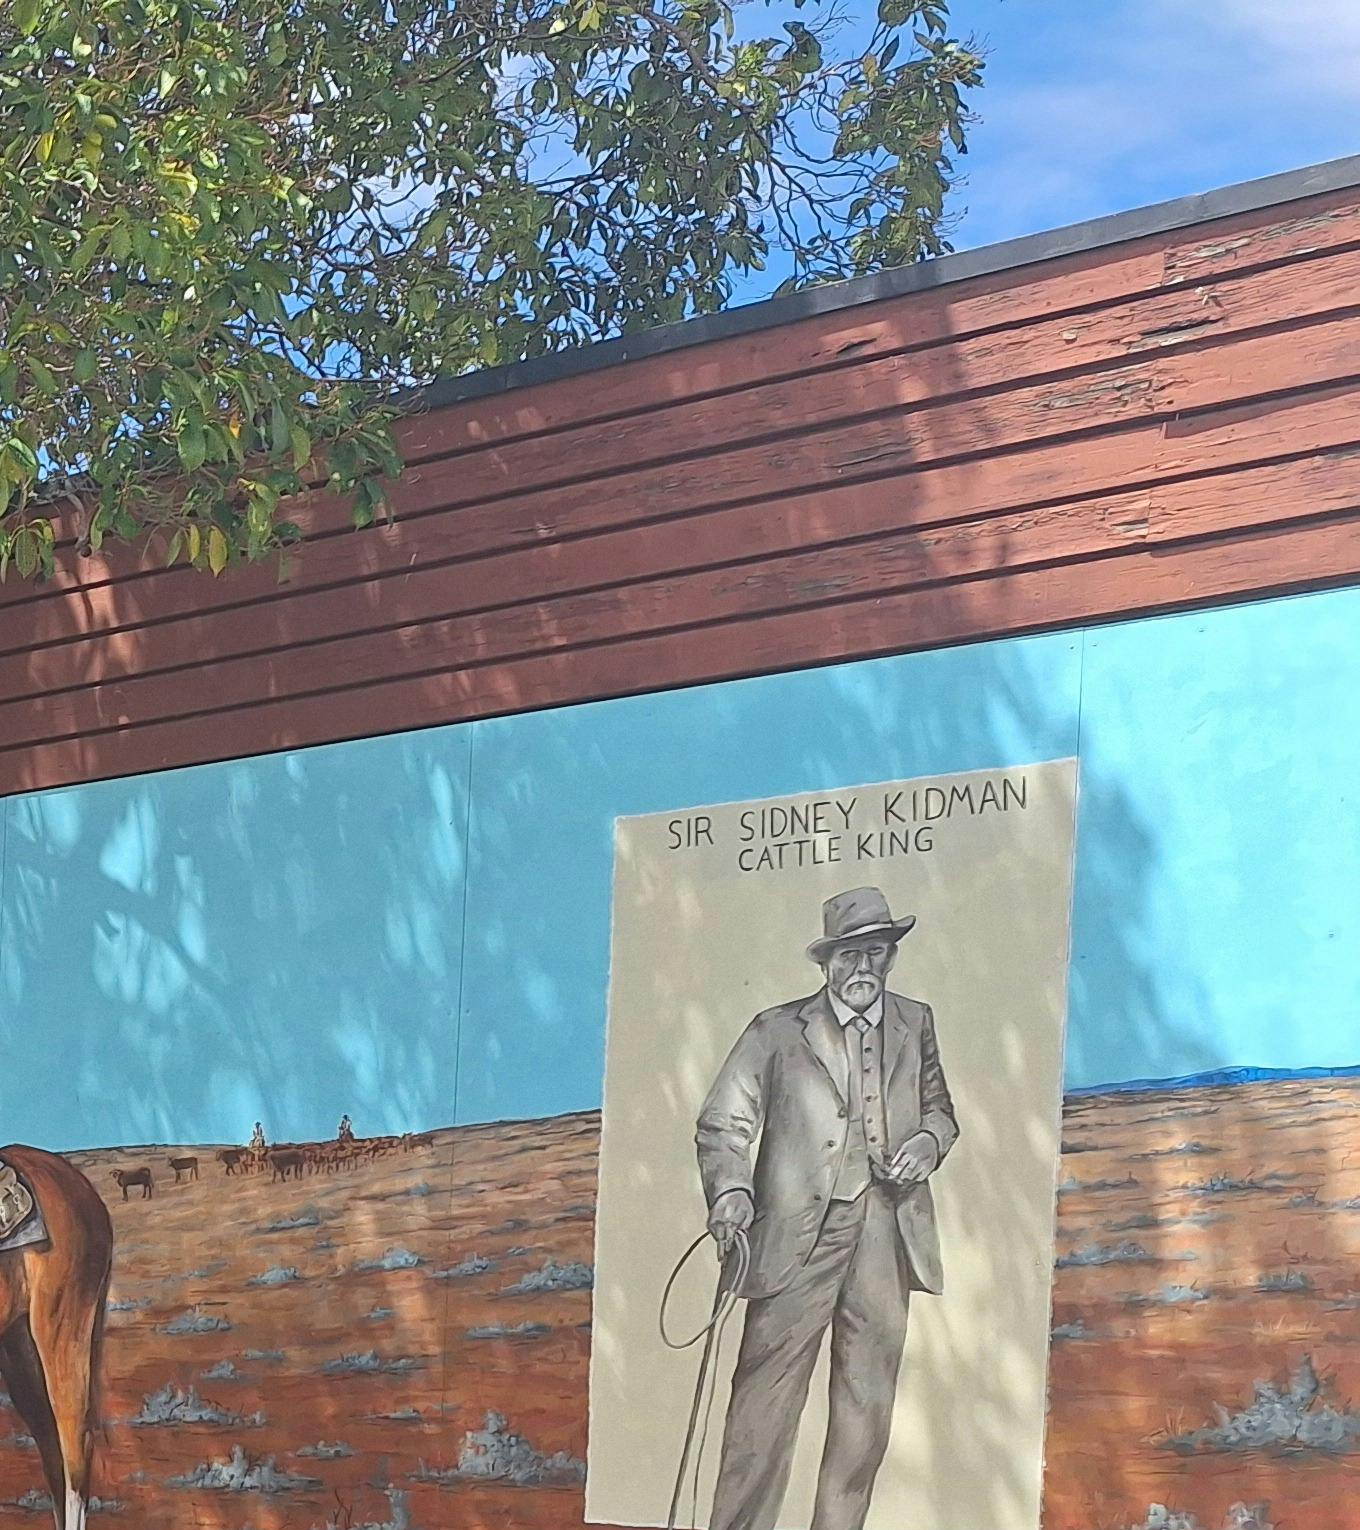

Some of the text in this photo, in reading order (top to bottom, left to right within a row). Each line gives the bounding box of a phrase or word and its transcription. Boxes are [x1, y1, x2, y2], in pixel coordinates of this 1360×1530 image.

[668, 775, 1026, 850] SIR SIDNEY KIDMAN
[738, 826, 934, 872] CATTLE KING
